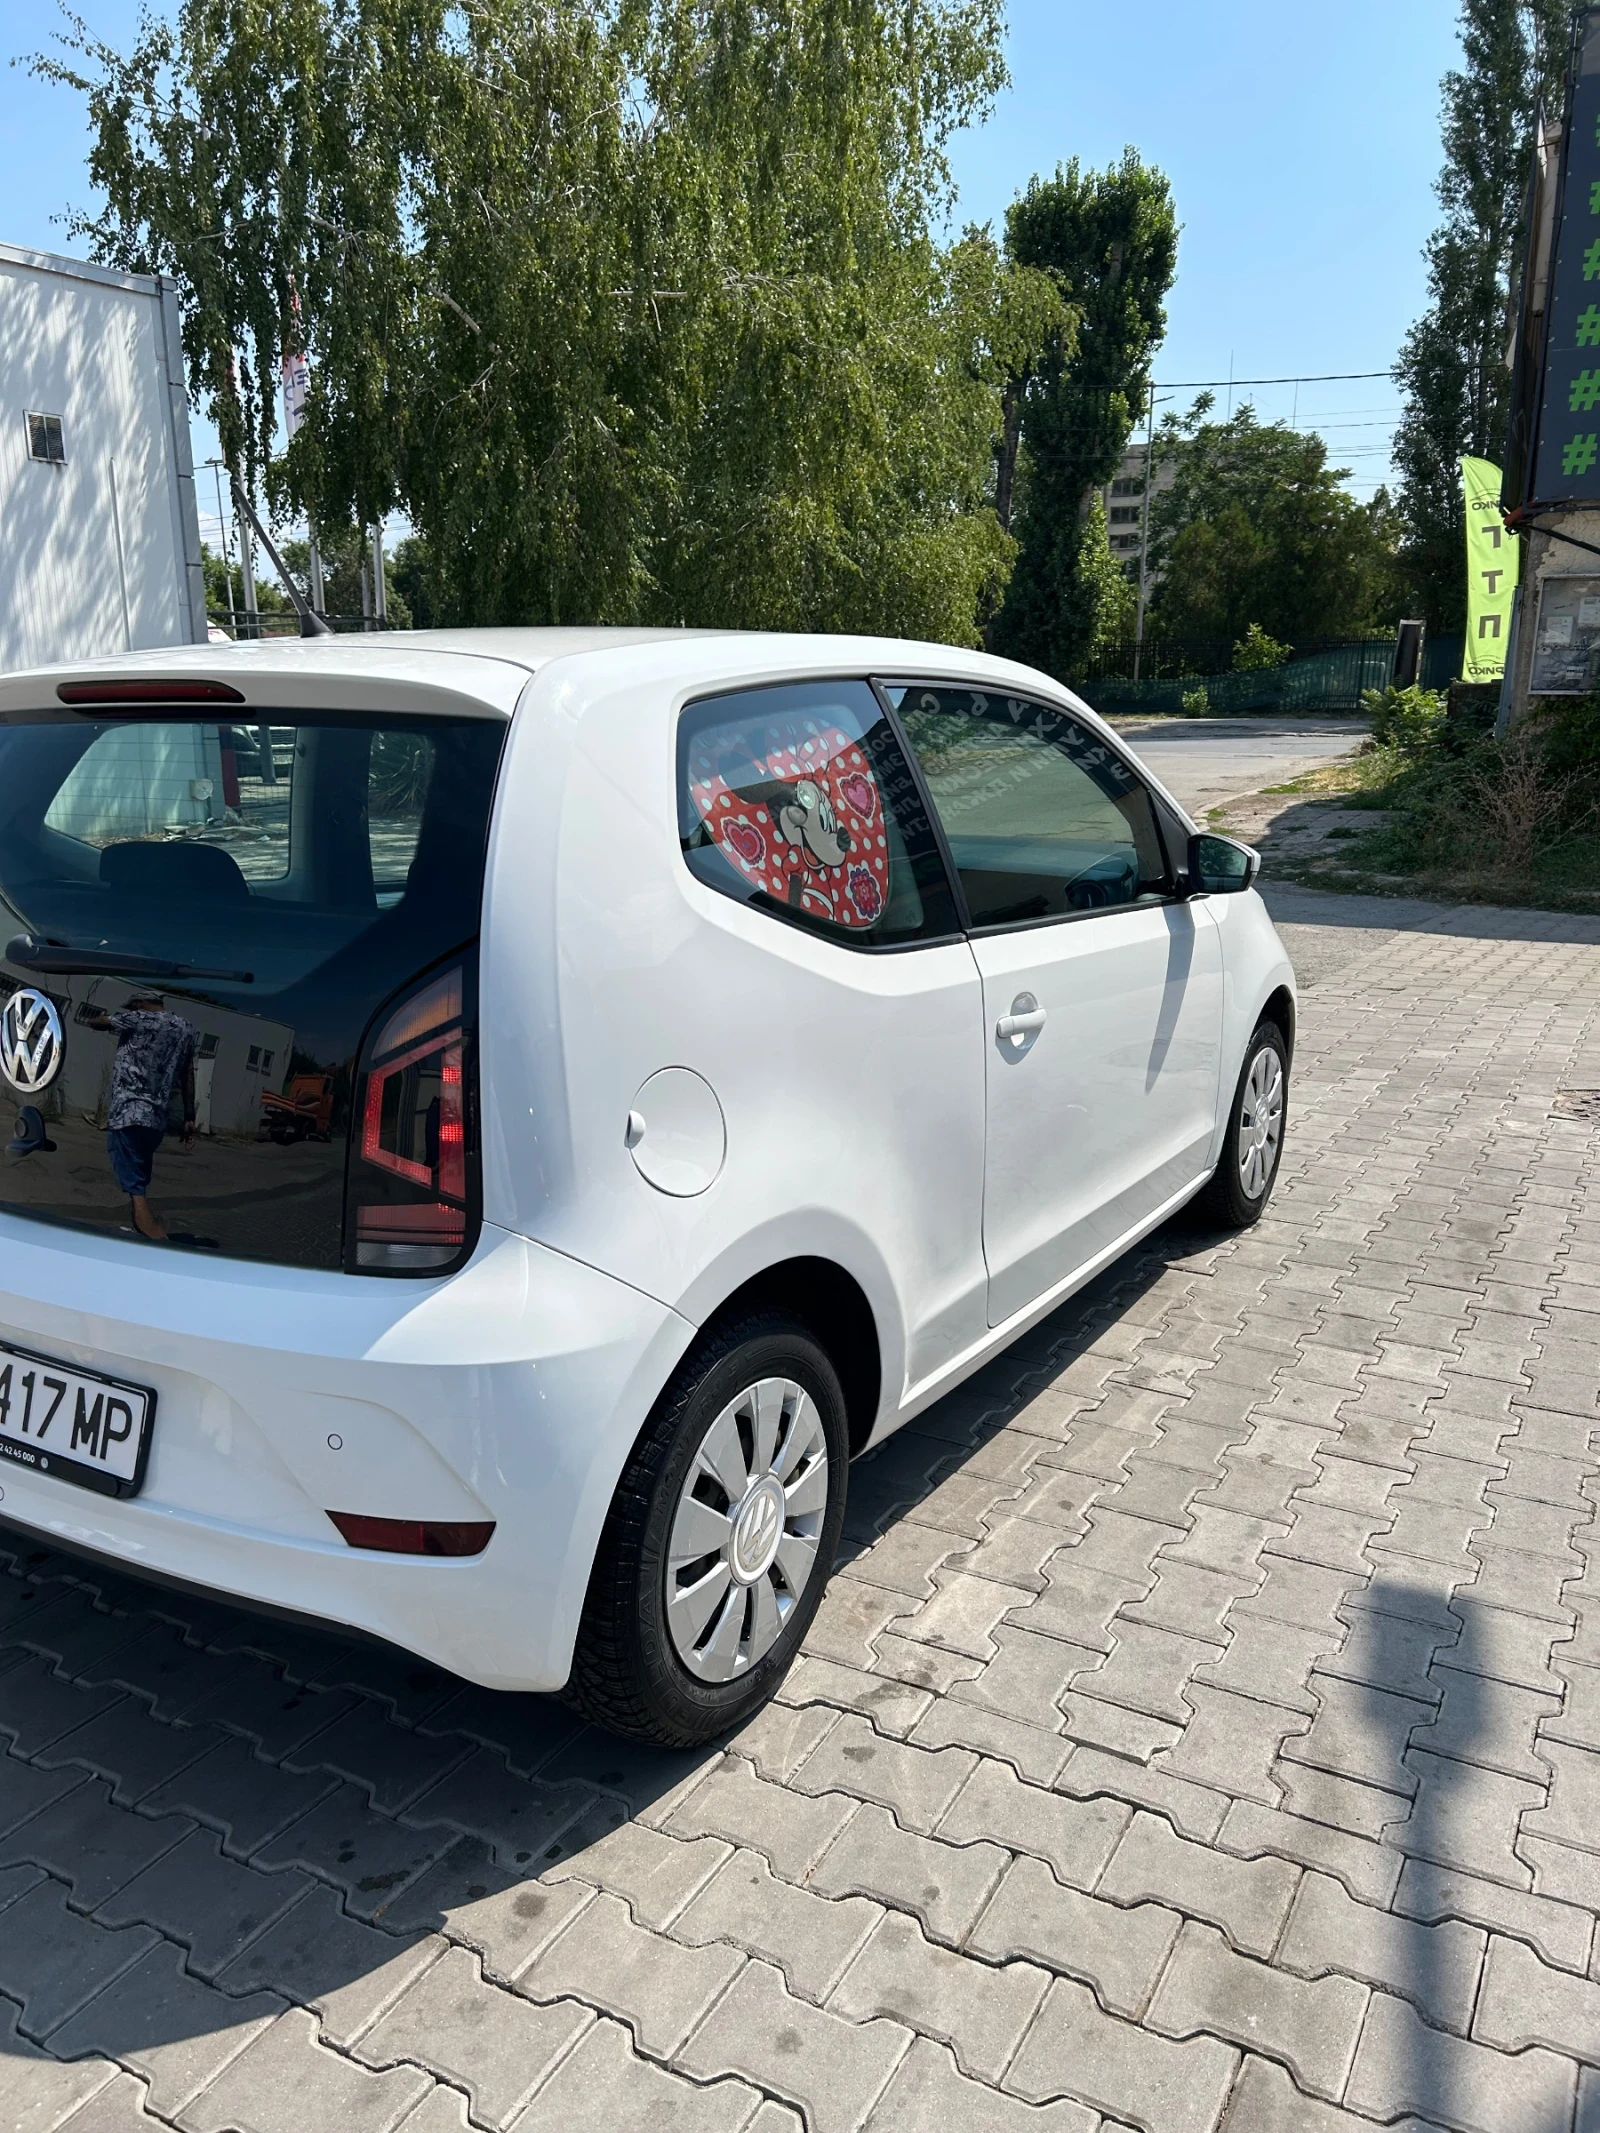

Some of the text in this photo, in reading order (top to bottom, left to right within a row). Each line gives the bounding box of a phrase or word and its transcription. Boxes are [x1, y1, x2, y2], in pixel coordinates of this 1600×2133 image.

[70, 1386, 132, 1460] MP
[13, 1449, 22, 1459] 45
[22, 1452, 35, 1463] 000
